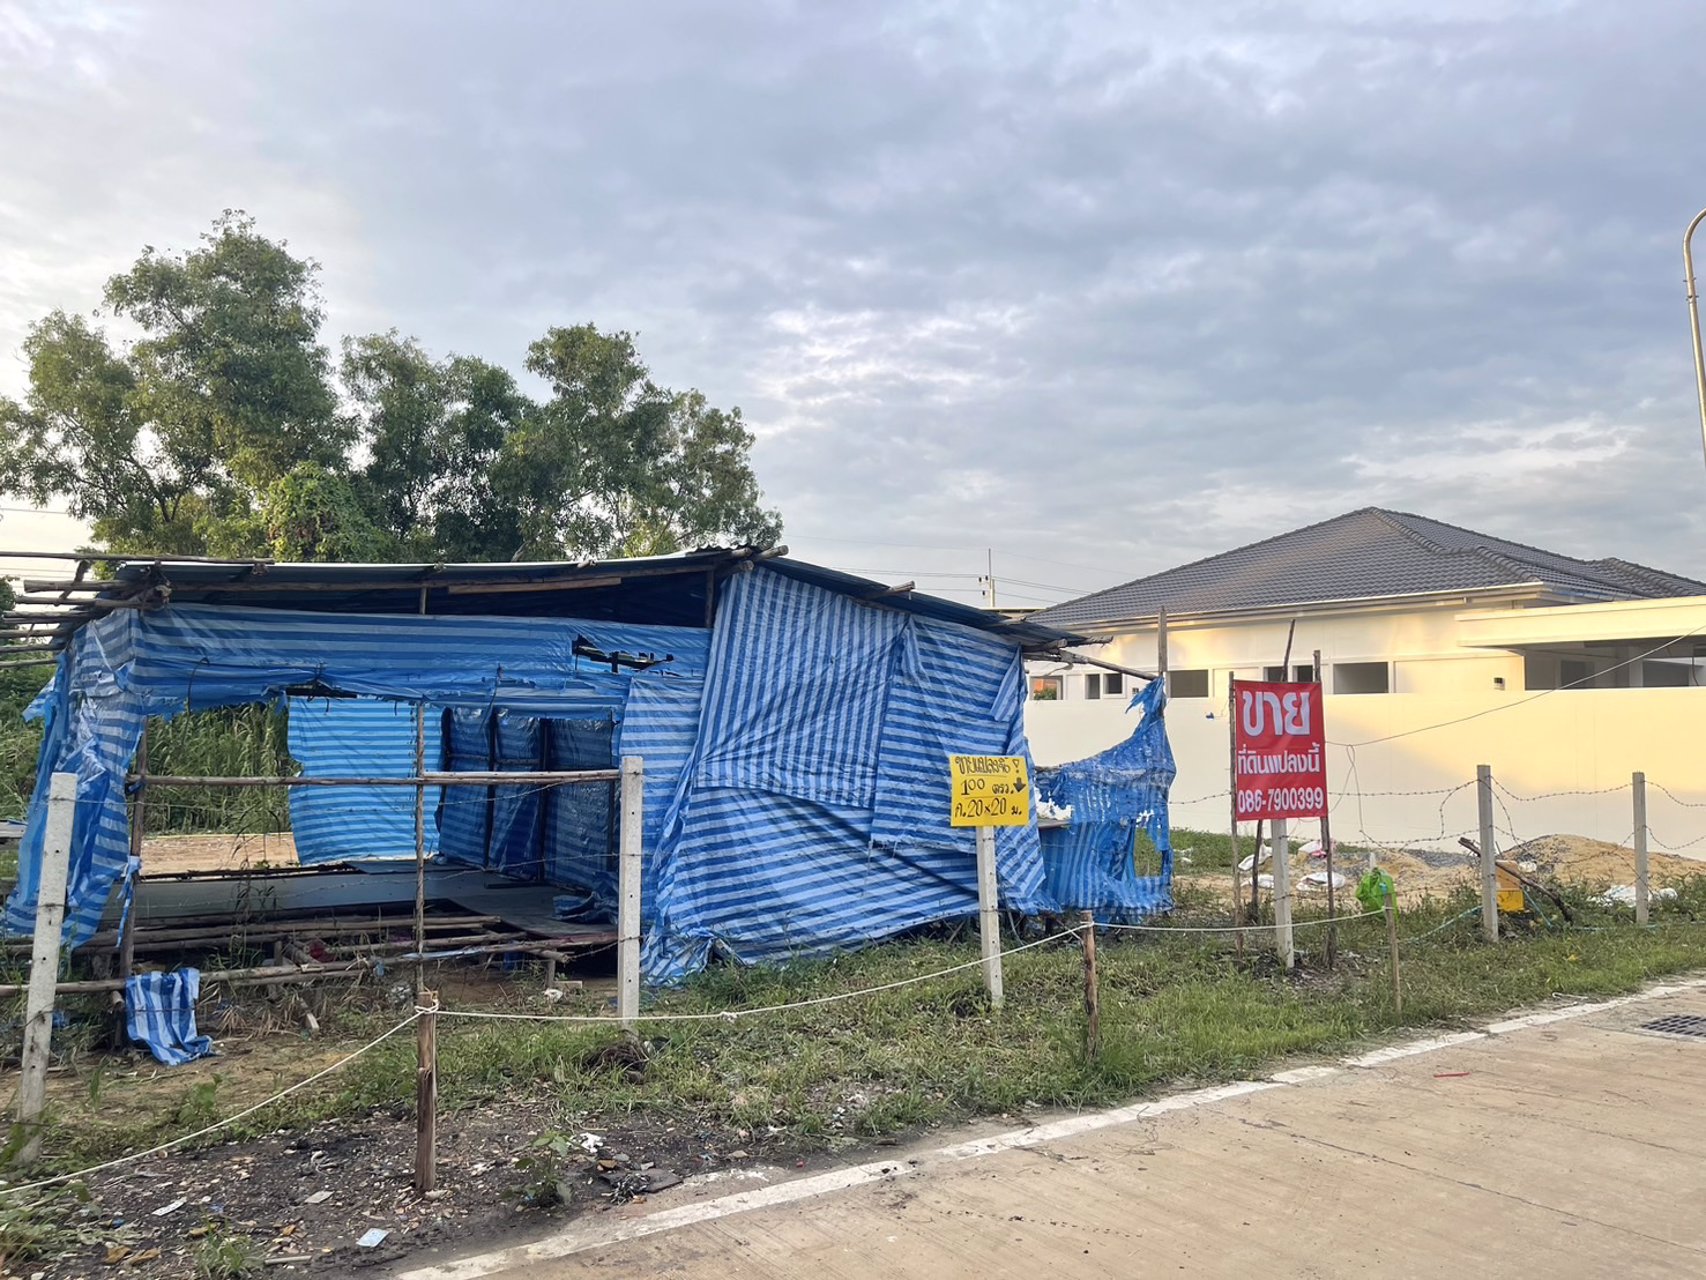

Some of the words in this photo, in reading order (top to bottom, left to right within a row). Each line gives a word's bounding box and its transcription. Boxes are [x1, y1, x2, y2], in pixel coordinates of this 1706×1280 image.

[1242, 691, 1310, 736] ขาย
[1237, 742, 1320, 774] ที่ดินแปลงนี้
[961, 778, 985, 795] 100
[1238, 786, 1324, 813] 086-7900399
